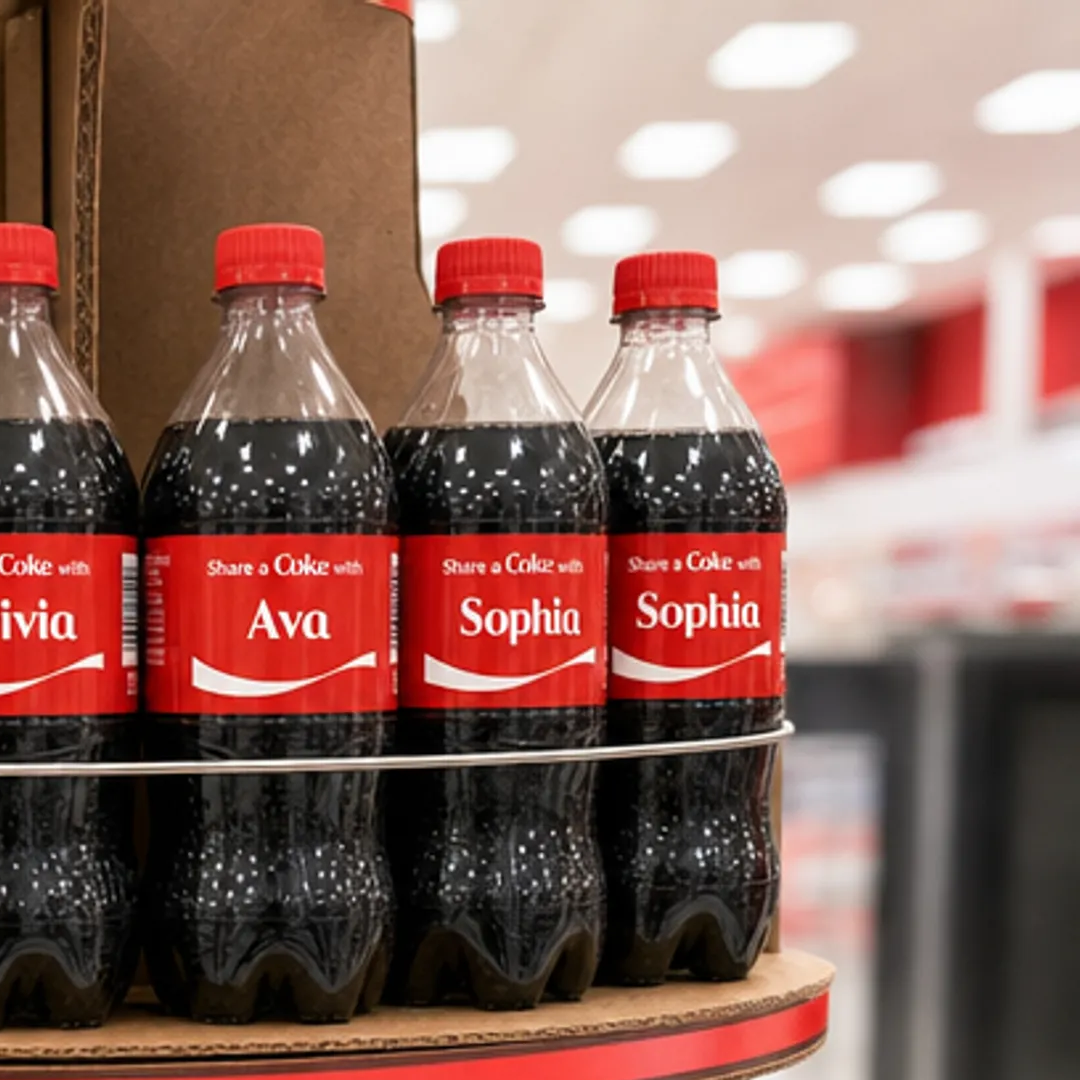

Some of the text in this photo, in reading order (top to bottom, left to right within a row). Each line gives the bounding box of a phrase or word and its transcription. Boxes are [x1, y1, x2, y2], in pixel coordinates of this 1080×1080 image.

[207, 559, 254, 576] Share
[273, 553, 329, 576] Coke
[442, 558, 486, 575] Share
[505, 552, 554, 575] Coke
[627, 555, 668, 573] Share
[685, 551, 732, 571] Coke
[246, 598, 331, 640] Ava
[460, 597, 581, 646] Sophia
[636, 591, 761, 638] Sophia
